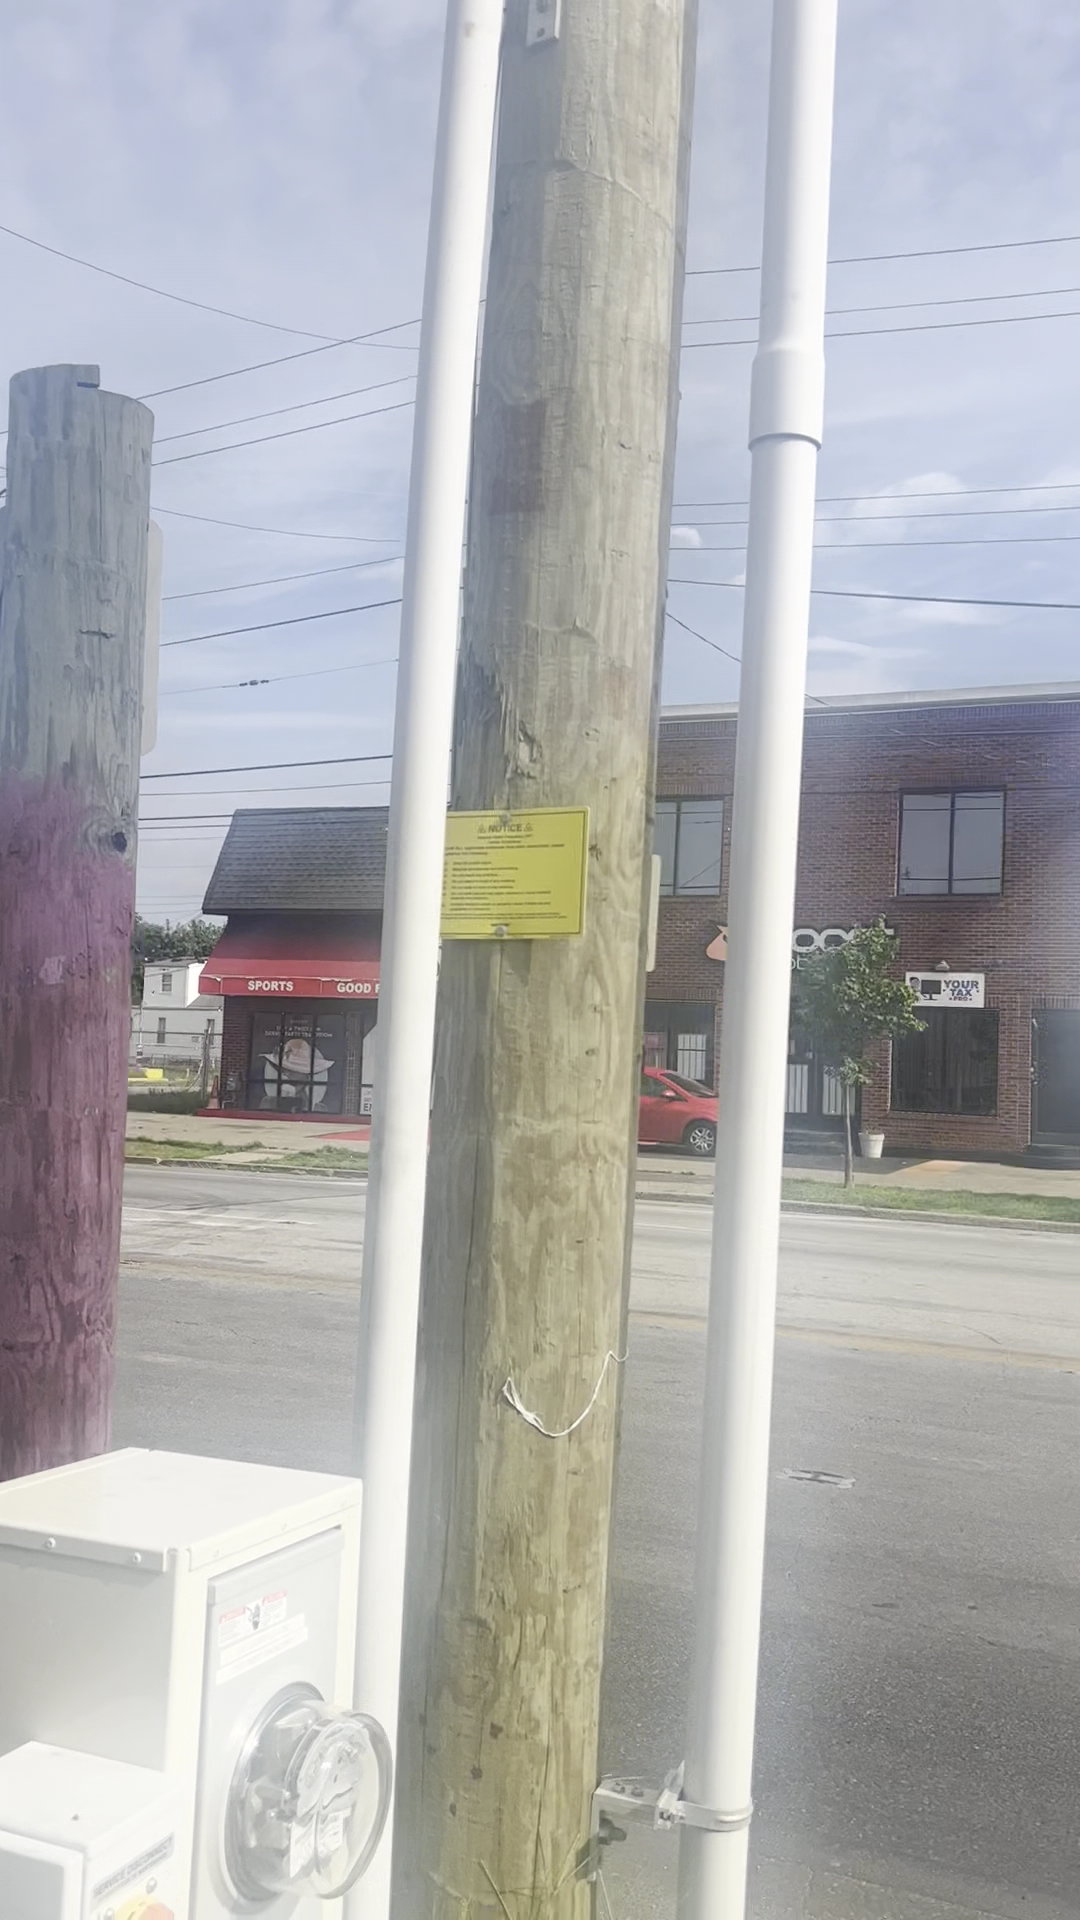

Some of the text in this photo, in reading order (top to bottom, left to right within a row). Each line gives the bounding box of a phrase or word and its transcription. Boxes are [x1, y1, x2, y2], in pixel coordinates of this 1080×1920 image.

[488, 824, 522, 832] NOTICE
[247, 980, 294, 991] SPORTS
[337, 982, 371, 993] GOOD
[944, 979, 979, 989] YOUR
[950, 988, 972, 997] TAX
